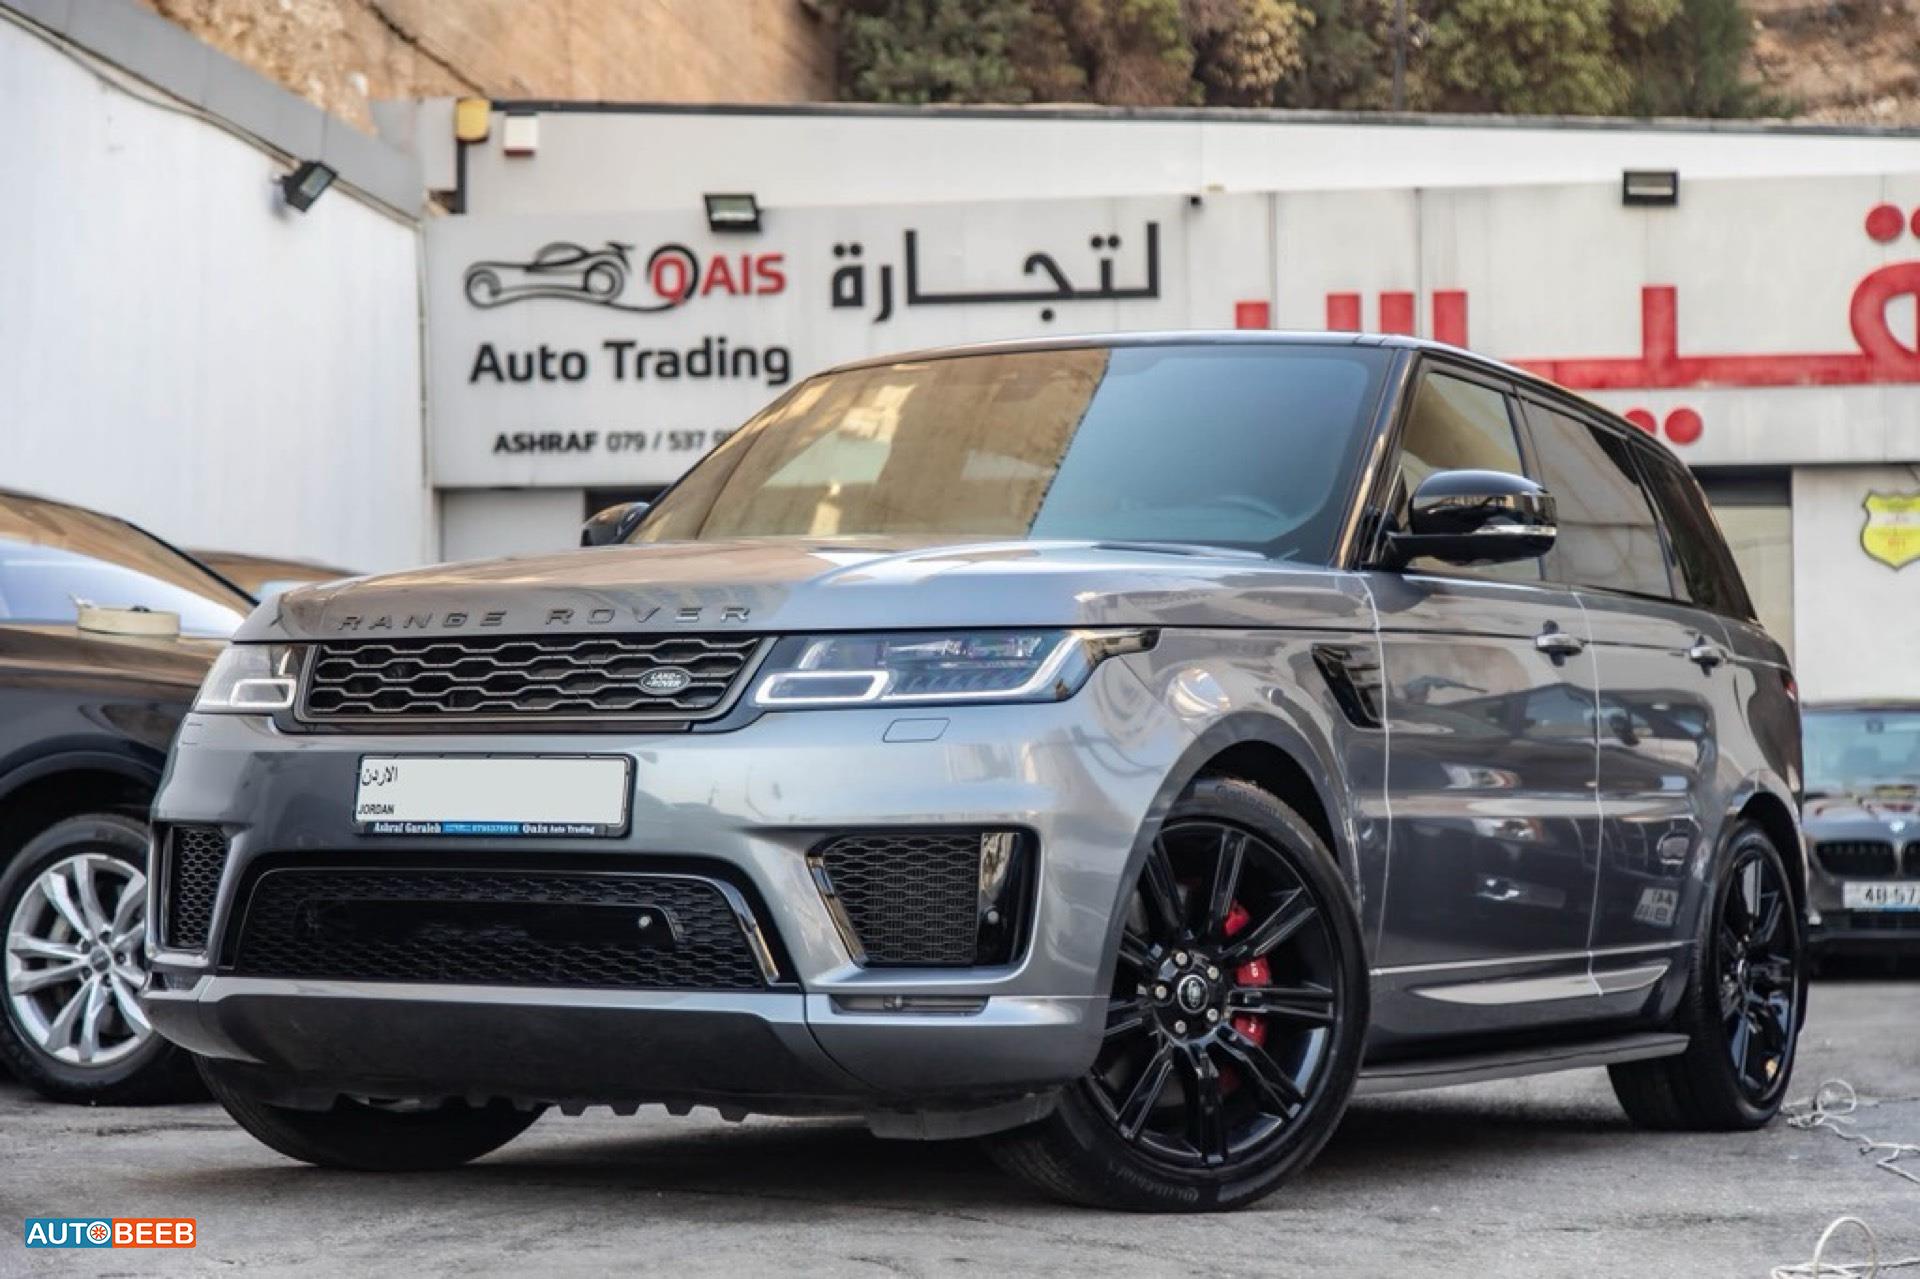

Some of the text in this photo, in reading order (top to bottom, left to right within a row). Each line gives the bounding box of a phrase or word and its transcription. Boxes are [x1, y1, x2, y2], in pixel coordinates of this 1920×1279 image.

[652, 252, 788, 305] QAIS
[832, 220, 1160, 324] لتجارة
[468, 337, 791, 386] Auto Trading
[493, 430, 598, 453] ASHRAF
[606, 429, 646, 451] 079
[668, 428, 706, 451] 537
[337, 606, 750, 631] RANGE ROVER
[357, 804, 394, 815] JORDAN
